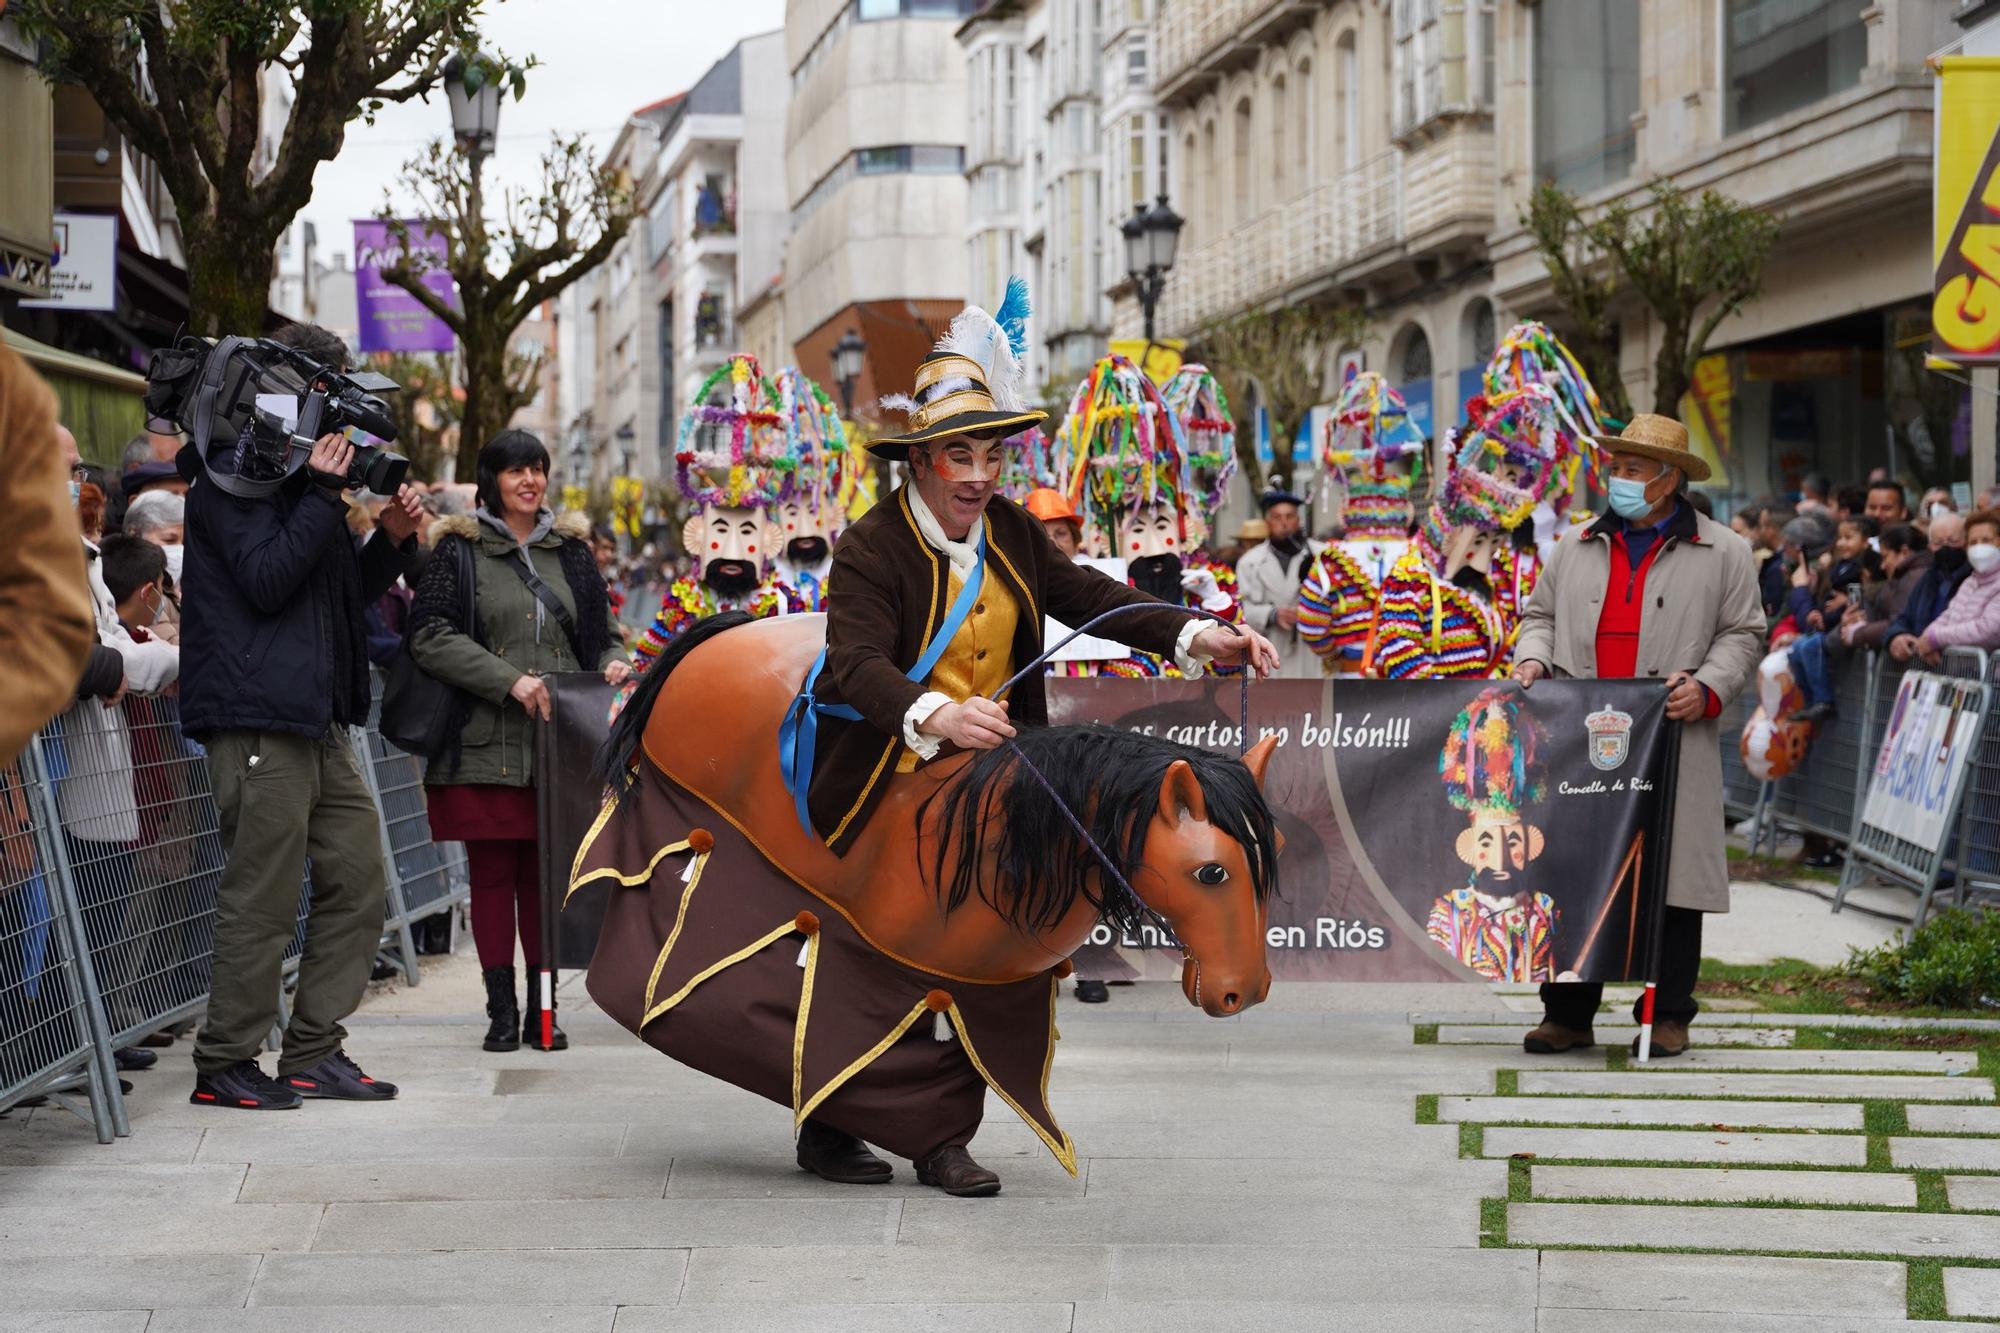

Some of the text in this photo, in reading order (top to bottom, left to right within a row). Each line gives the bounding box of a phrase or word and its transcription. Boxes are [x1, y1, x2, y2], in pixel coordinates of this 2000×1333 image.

[1166, 719, 1243, 747] cartos
[1301, 712, 1411, 748] bolsón!!!
[1558, 777, 1653, 795] Concello de Riós
[1266, 926, 1305, 948] en
[1316, 917, 1385, 949] Riós
